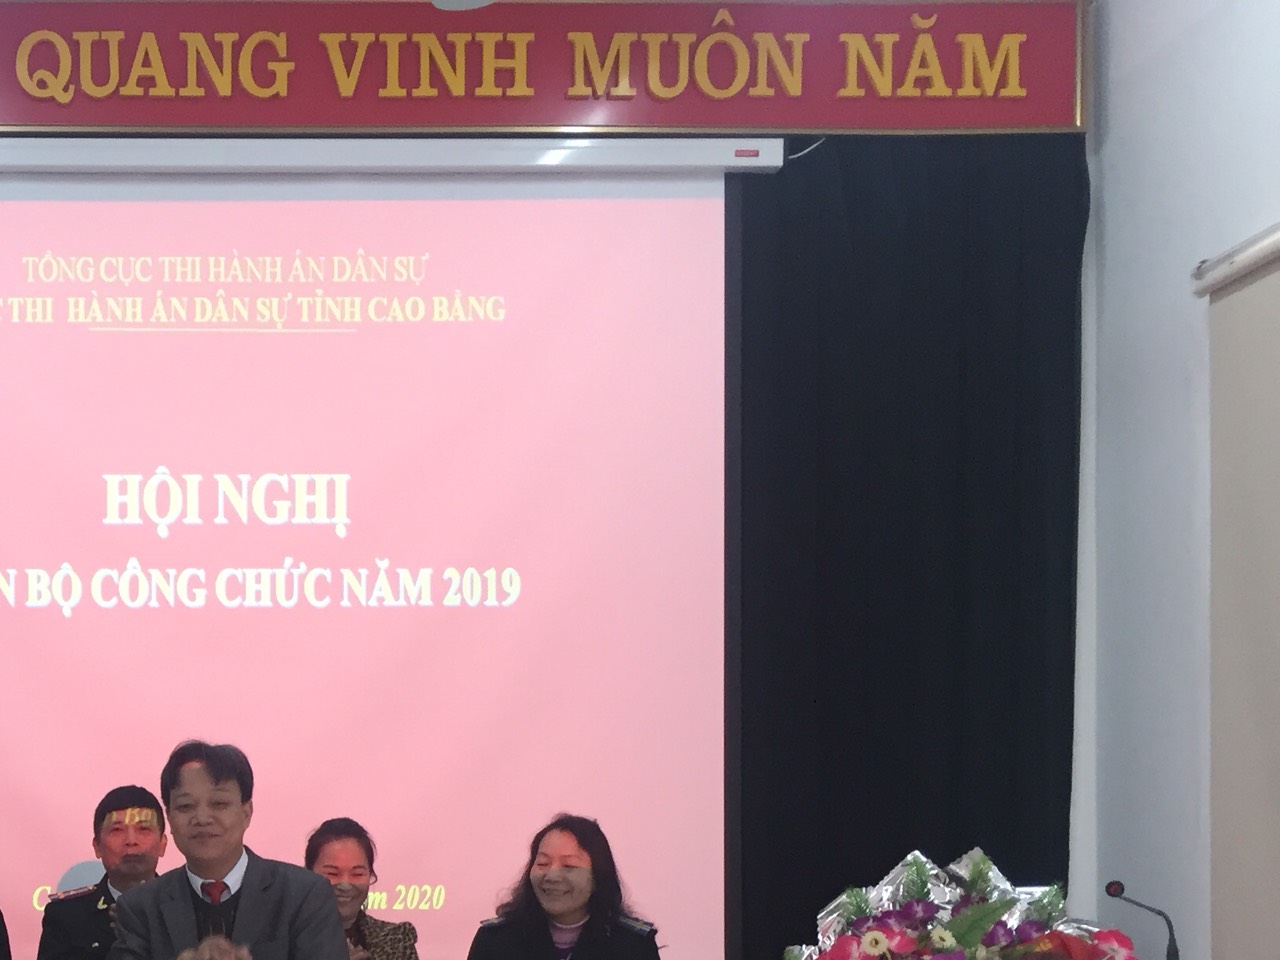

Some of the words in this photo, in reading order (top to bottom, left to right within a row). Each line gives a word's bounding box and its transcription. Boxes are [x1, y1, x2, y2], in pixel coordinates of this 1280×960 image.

[16, 30, 296, 104] QUANG
[320, 33, 534, 98] VINH
[567, 8, 810, 98] MUÔN
[837, 12, 1027, 97] NĂM
[100, 256, 152, 286] CỤC
[159, 256, 201, 282] THI
[208, 248, 282, 282] HÀNH
[288, 248, 325, 282] ÁN
[332, 247, 388, 282] DÂN
[394, 252, 430, 285] SỰ
[8, 297, 54, 323] THI
[67, 290, 143, 323] HÀNH
[150, 290, 188, 322] ÁN
[194, 289, 250, 322] DÂN
[256, 292, 293, 329] SỰ
[297, 289, 361, 322] TỈNH
[368, 296, 425, 322] CAO
[432, 288, 506, 322] BẰNG
[102, 465, 203, 538] HỘI
[213, 473, 352, 538] NGHỊ
[25, 563, 83, 618] BỘ
[91, 557, 207, 608] CÔNG
[214, 557, 332, 608] CHỨC
[341, 558, 434, 607] NĂM
[442, 568, 521, 607] 2019
[392, 884, 446, 910] 2020
